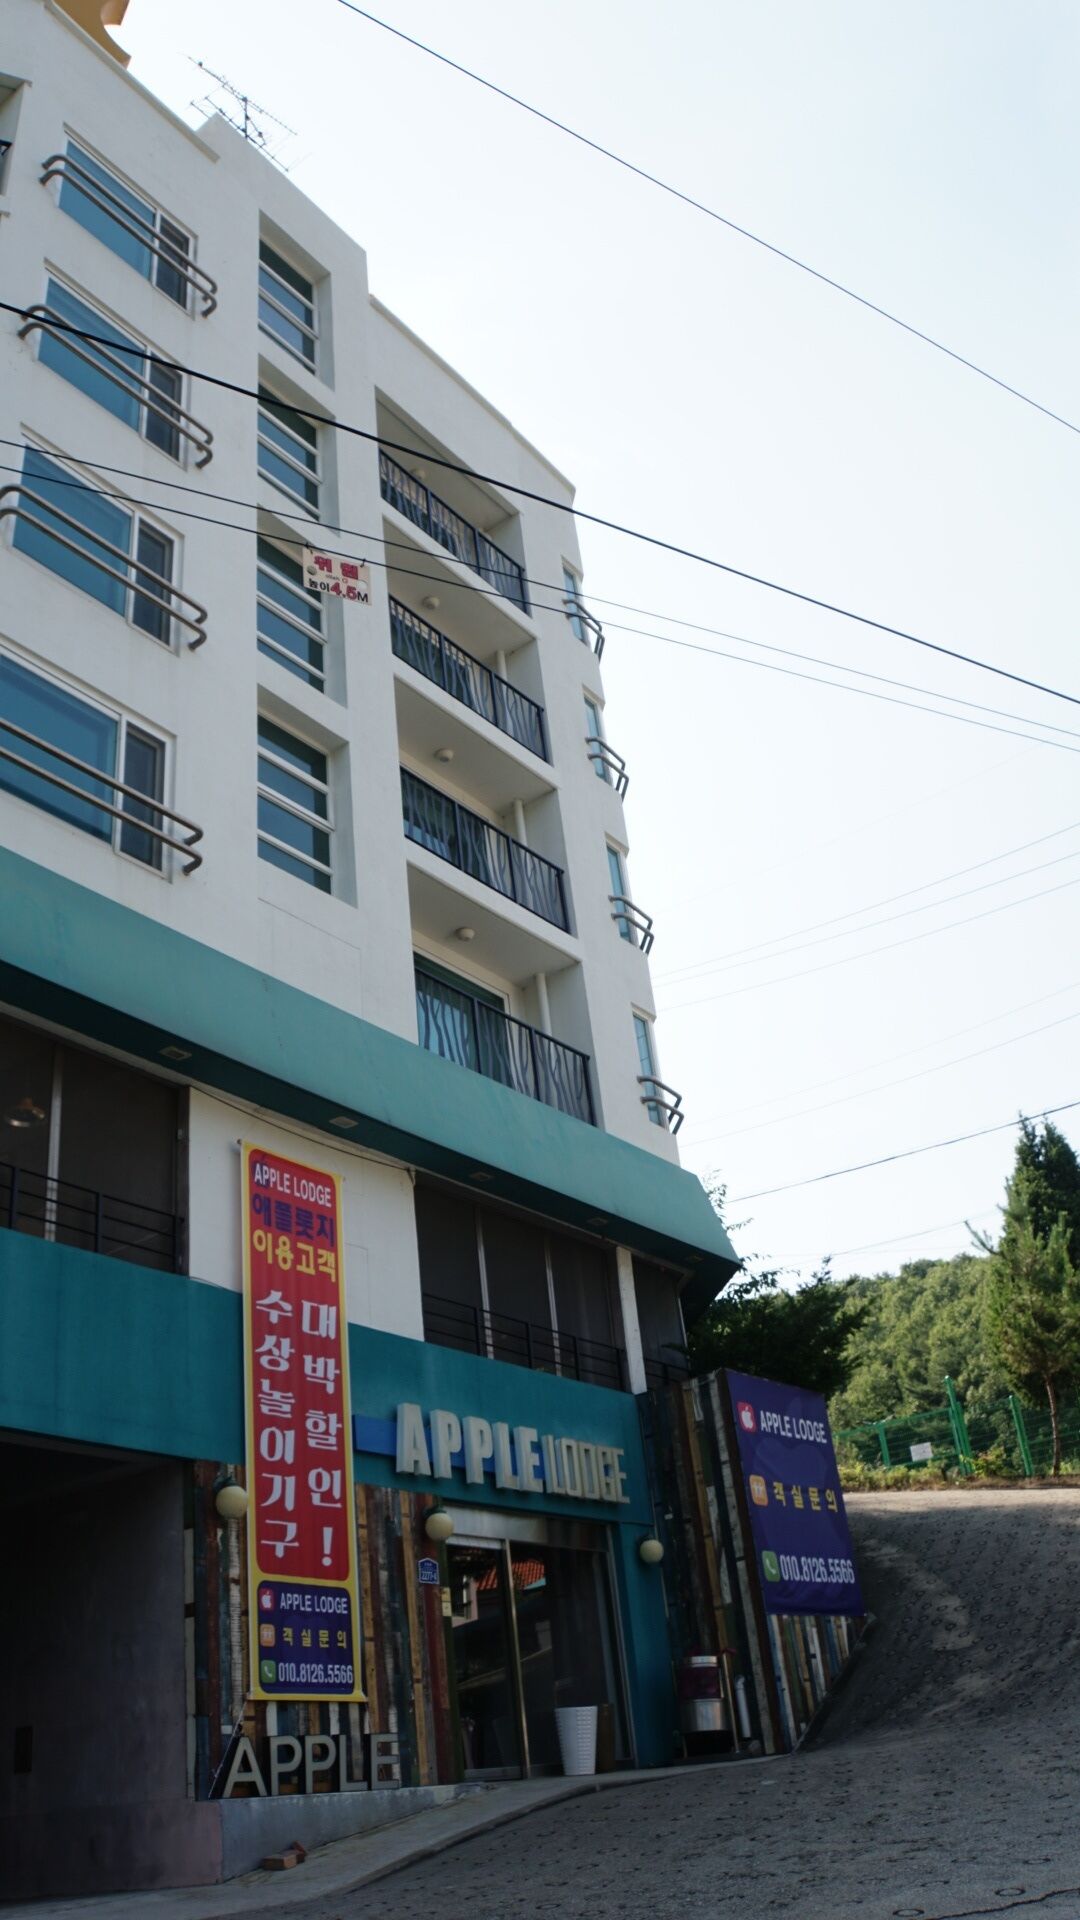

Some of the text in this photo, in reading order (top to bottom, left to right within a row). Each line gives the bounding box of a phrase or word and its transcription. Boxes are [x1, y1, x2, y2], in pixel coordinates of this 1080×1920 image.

[254, 1162, 332, 1208] APPLE LODGE
[252, 1229, 336, 1283] 이용고객
[760, 1410, 828, 1444] APPLE LODGE
[396, 1402, 543, 1494] APPLE
[779, 1554, 856, 1584] 010.8126.5566
[280, 1592, 348, 1615] APPLE LODGE
[278, 1662, 354, 1685] 010.8126.5566
[222, 1732, 400, 1799] APPLE
